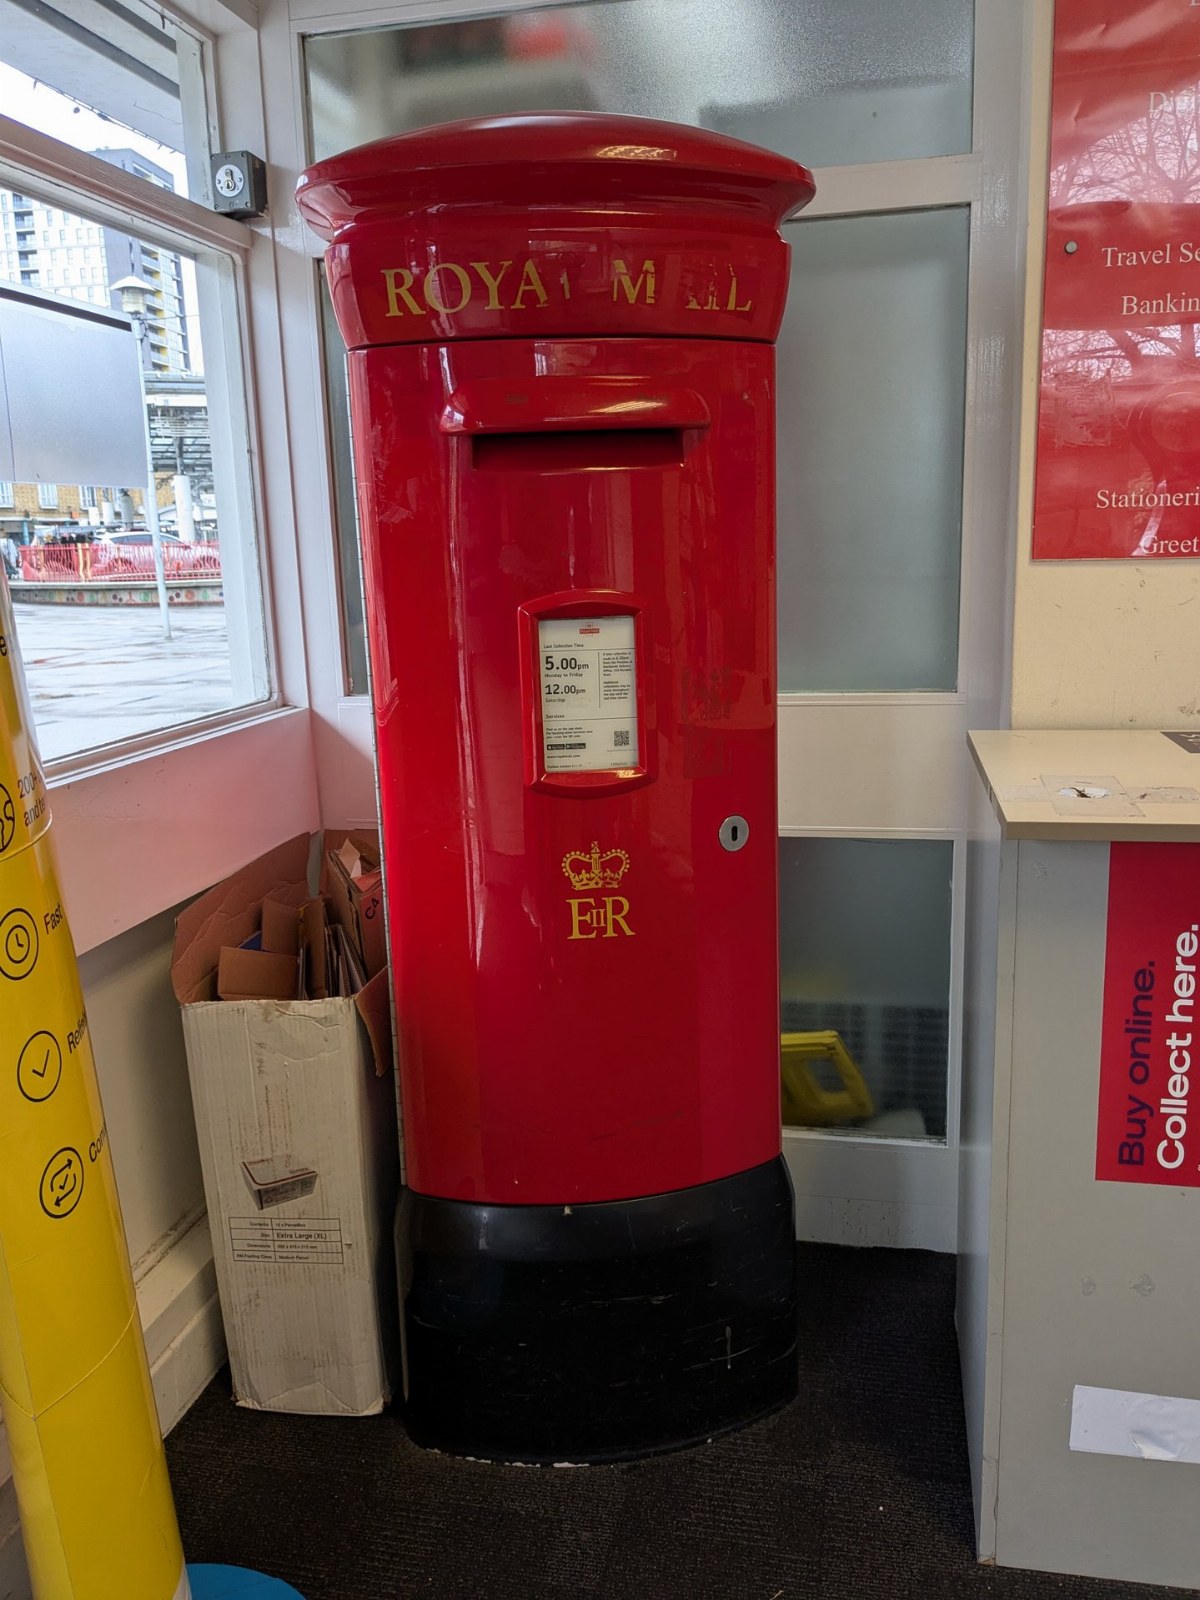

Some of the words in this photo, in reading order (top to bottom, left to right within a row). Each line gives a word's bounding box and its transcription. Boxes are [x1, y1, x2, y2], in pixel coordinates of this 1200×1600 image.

[1101, 243, 1171, 267] Travel
[1121, 291, 1200, 316] Bankin
[1096, 486, 1200, 509] Stationeri
[1140, 535, 1200, 554] Greet
[545, 655, 590, 671] 5.00pm
[545, 683, 586, 695] 12.00pm
[43, 902, 63, 935] Fast
[365, 897, 380, 920] C4
[1165, 923, 1200, 1023] here.
[1124, 960, 1156, 1085] online.
[1156, 1032, 1194, 1170] Collect
[1118, 1094, 1155, 1167] Buy
